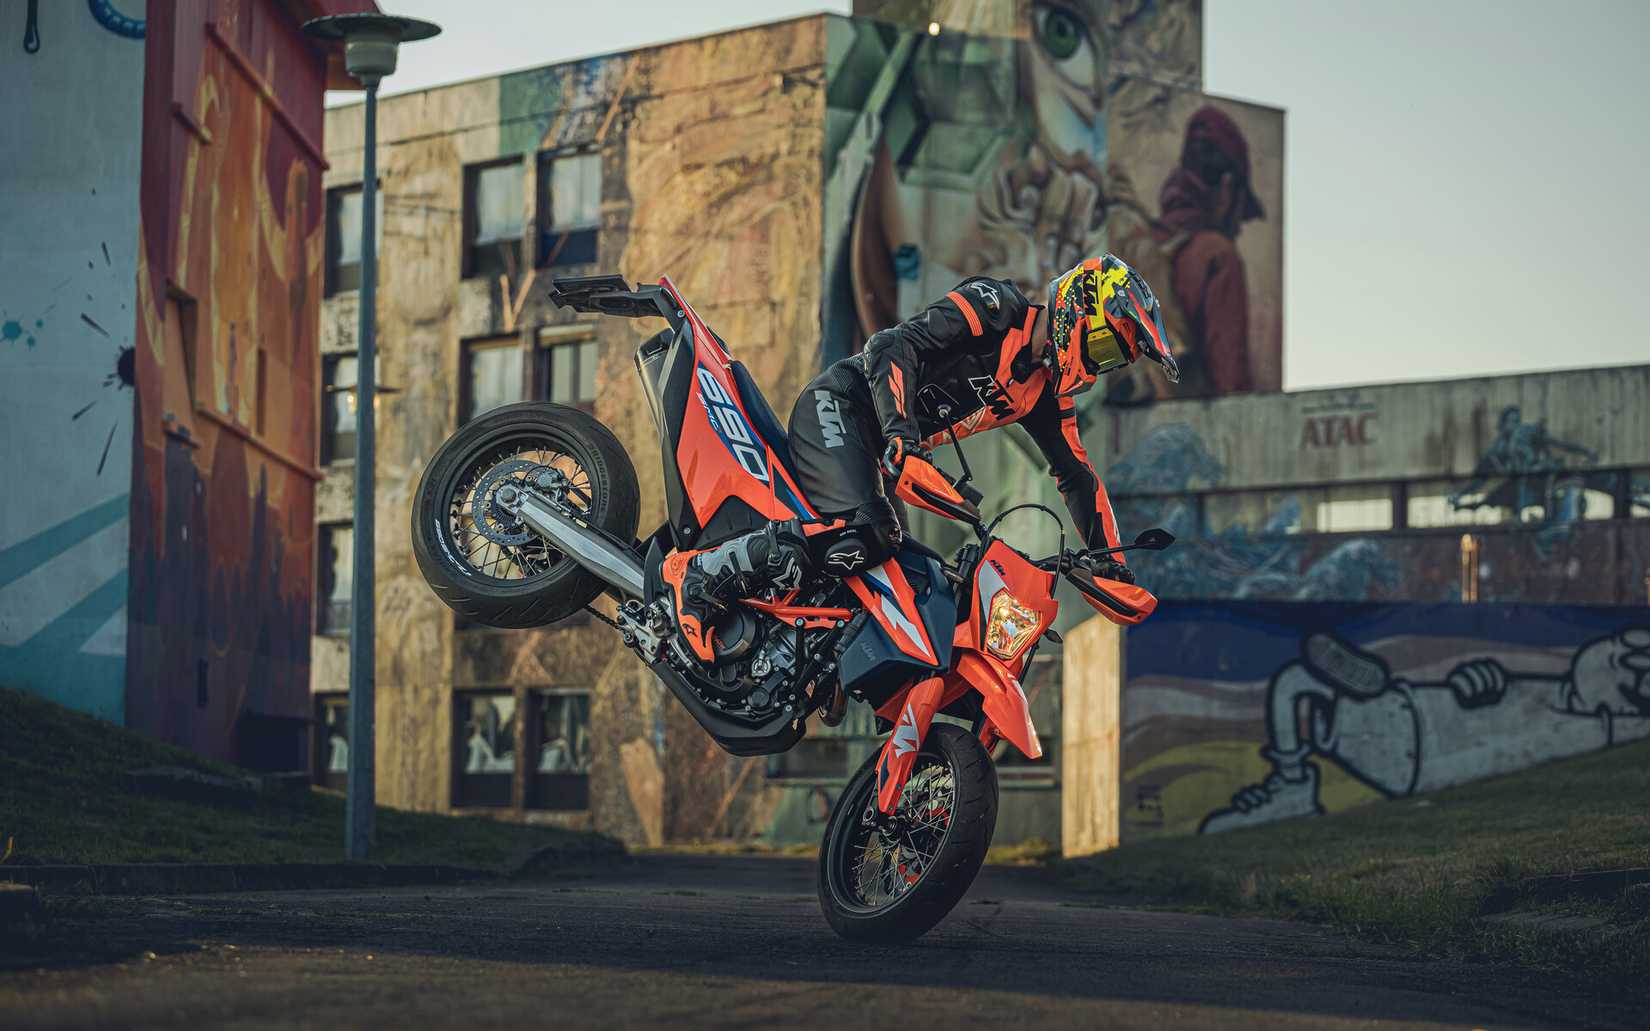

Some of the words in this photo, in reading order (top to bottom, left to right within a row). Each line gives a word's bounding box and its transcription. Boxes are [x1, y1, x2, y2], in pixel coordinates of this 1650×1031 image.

[1083, 270, 1099, 315] KTM
[814, 390, 846, 448] KTM
[968, 375, 1015, 420] KTM
[697, 368, 769, 481] 690
[1302, 413, 1377, 448] ATAC
[893, 703, 920, 758] TM
